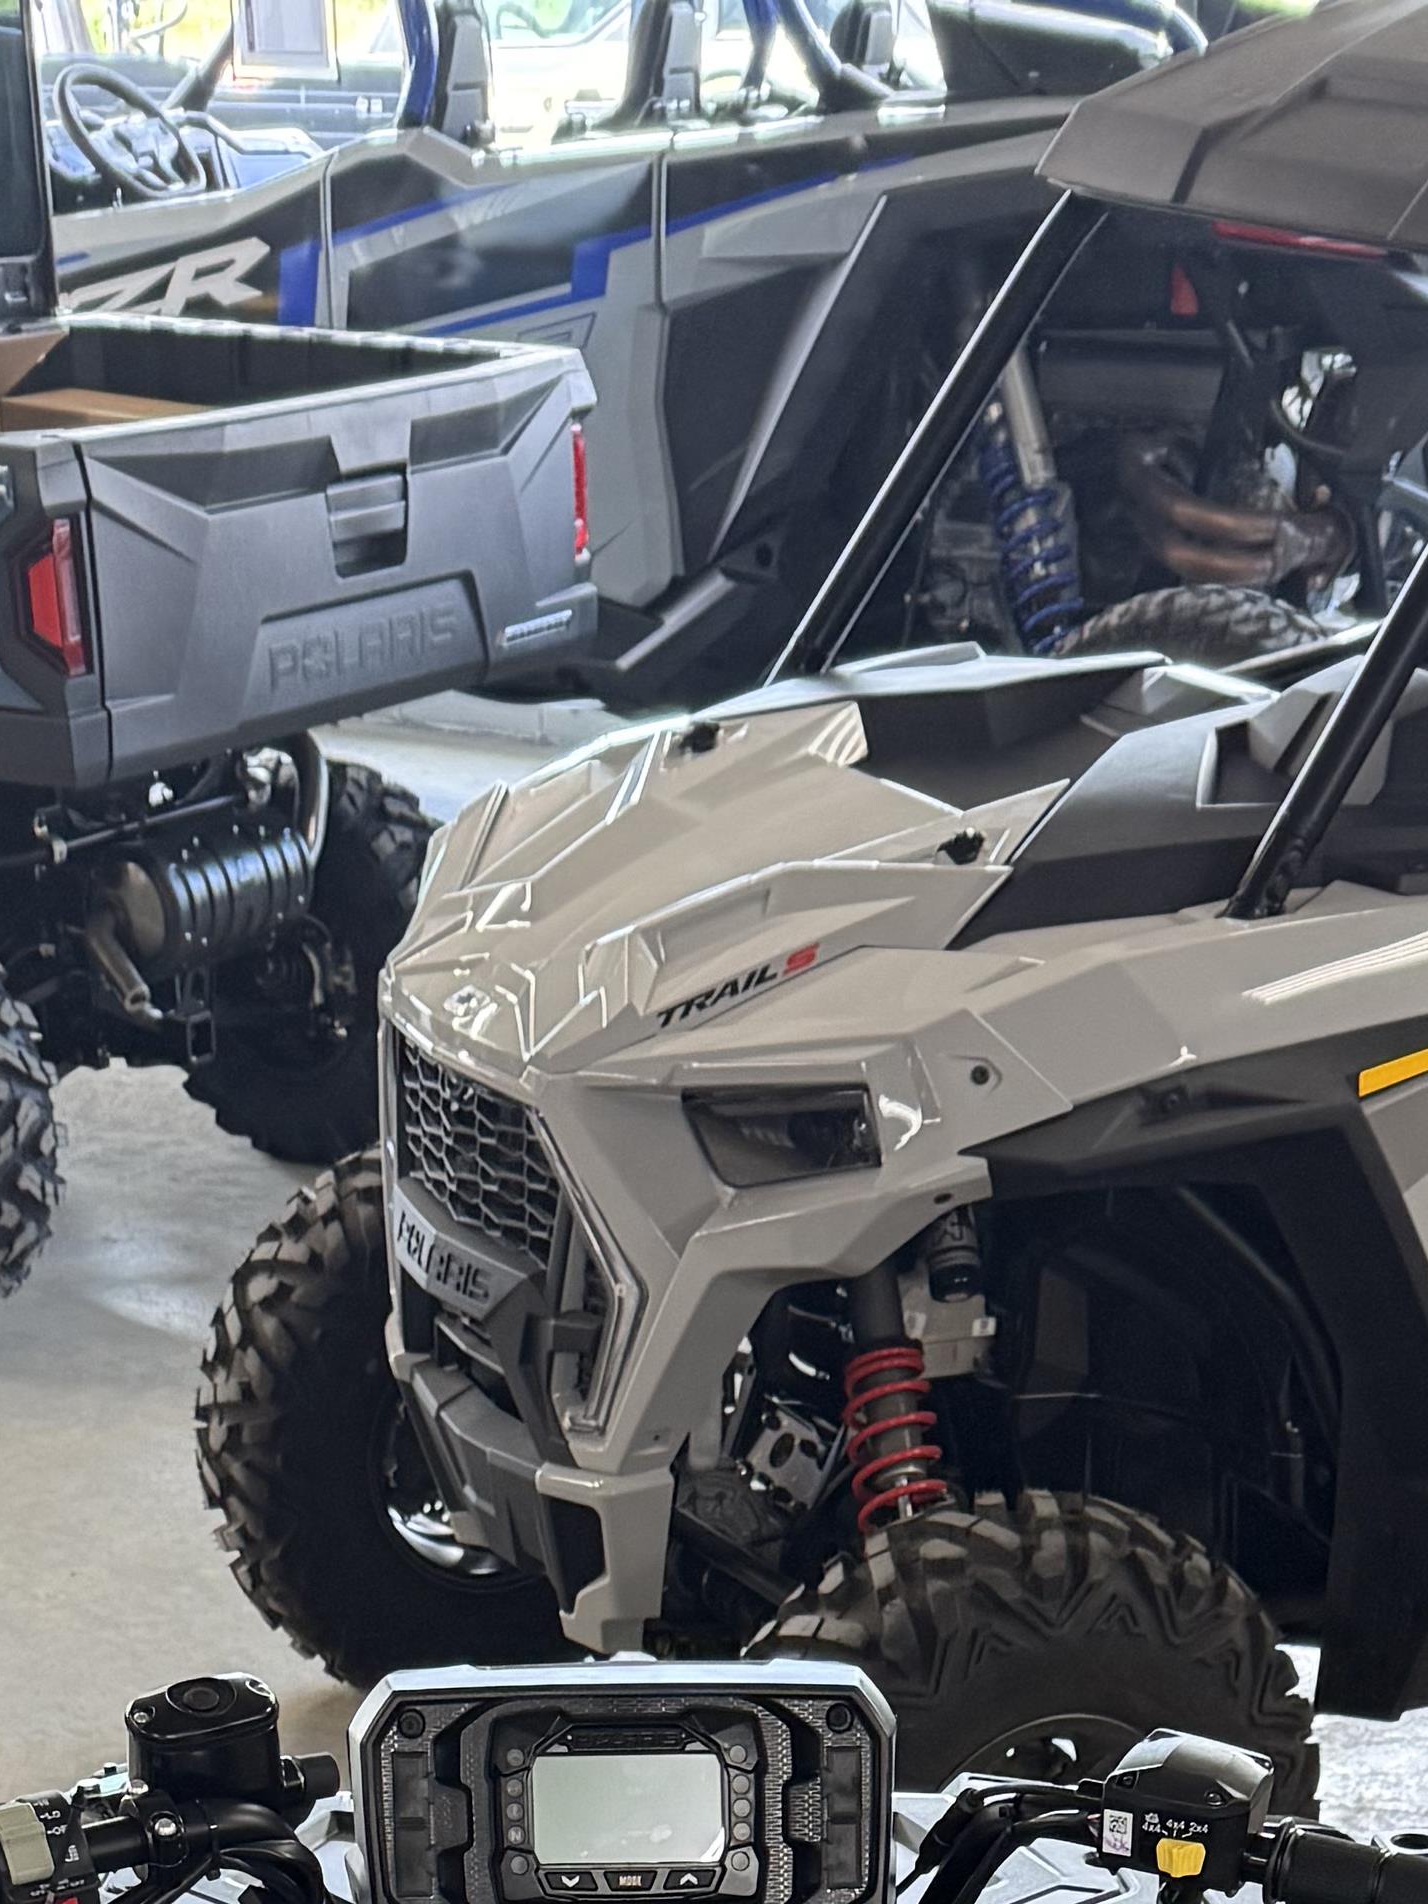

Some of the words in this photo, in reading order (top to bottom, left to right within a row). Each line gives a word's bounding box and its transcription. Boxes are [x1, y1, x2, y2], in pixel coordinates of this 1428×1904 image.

[268, 606, 458, 694] POLARIS
[657, 964, 778, 1028] TRAIL
[397, 1210, 490, 1300] POLARIS
